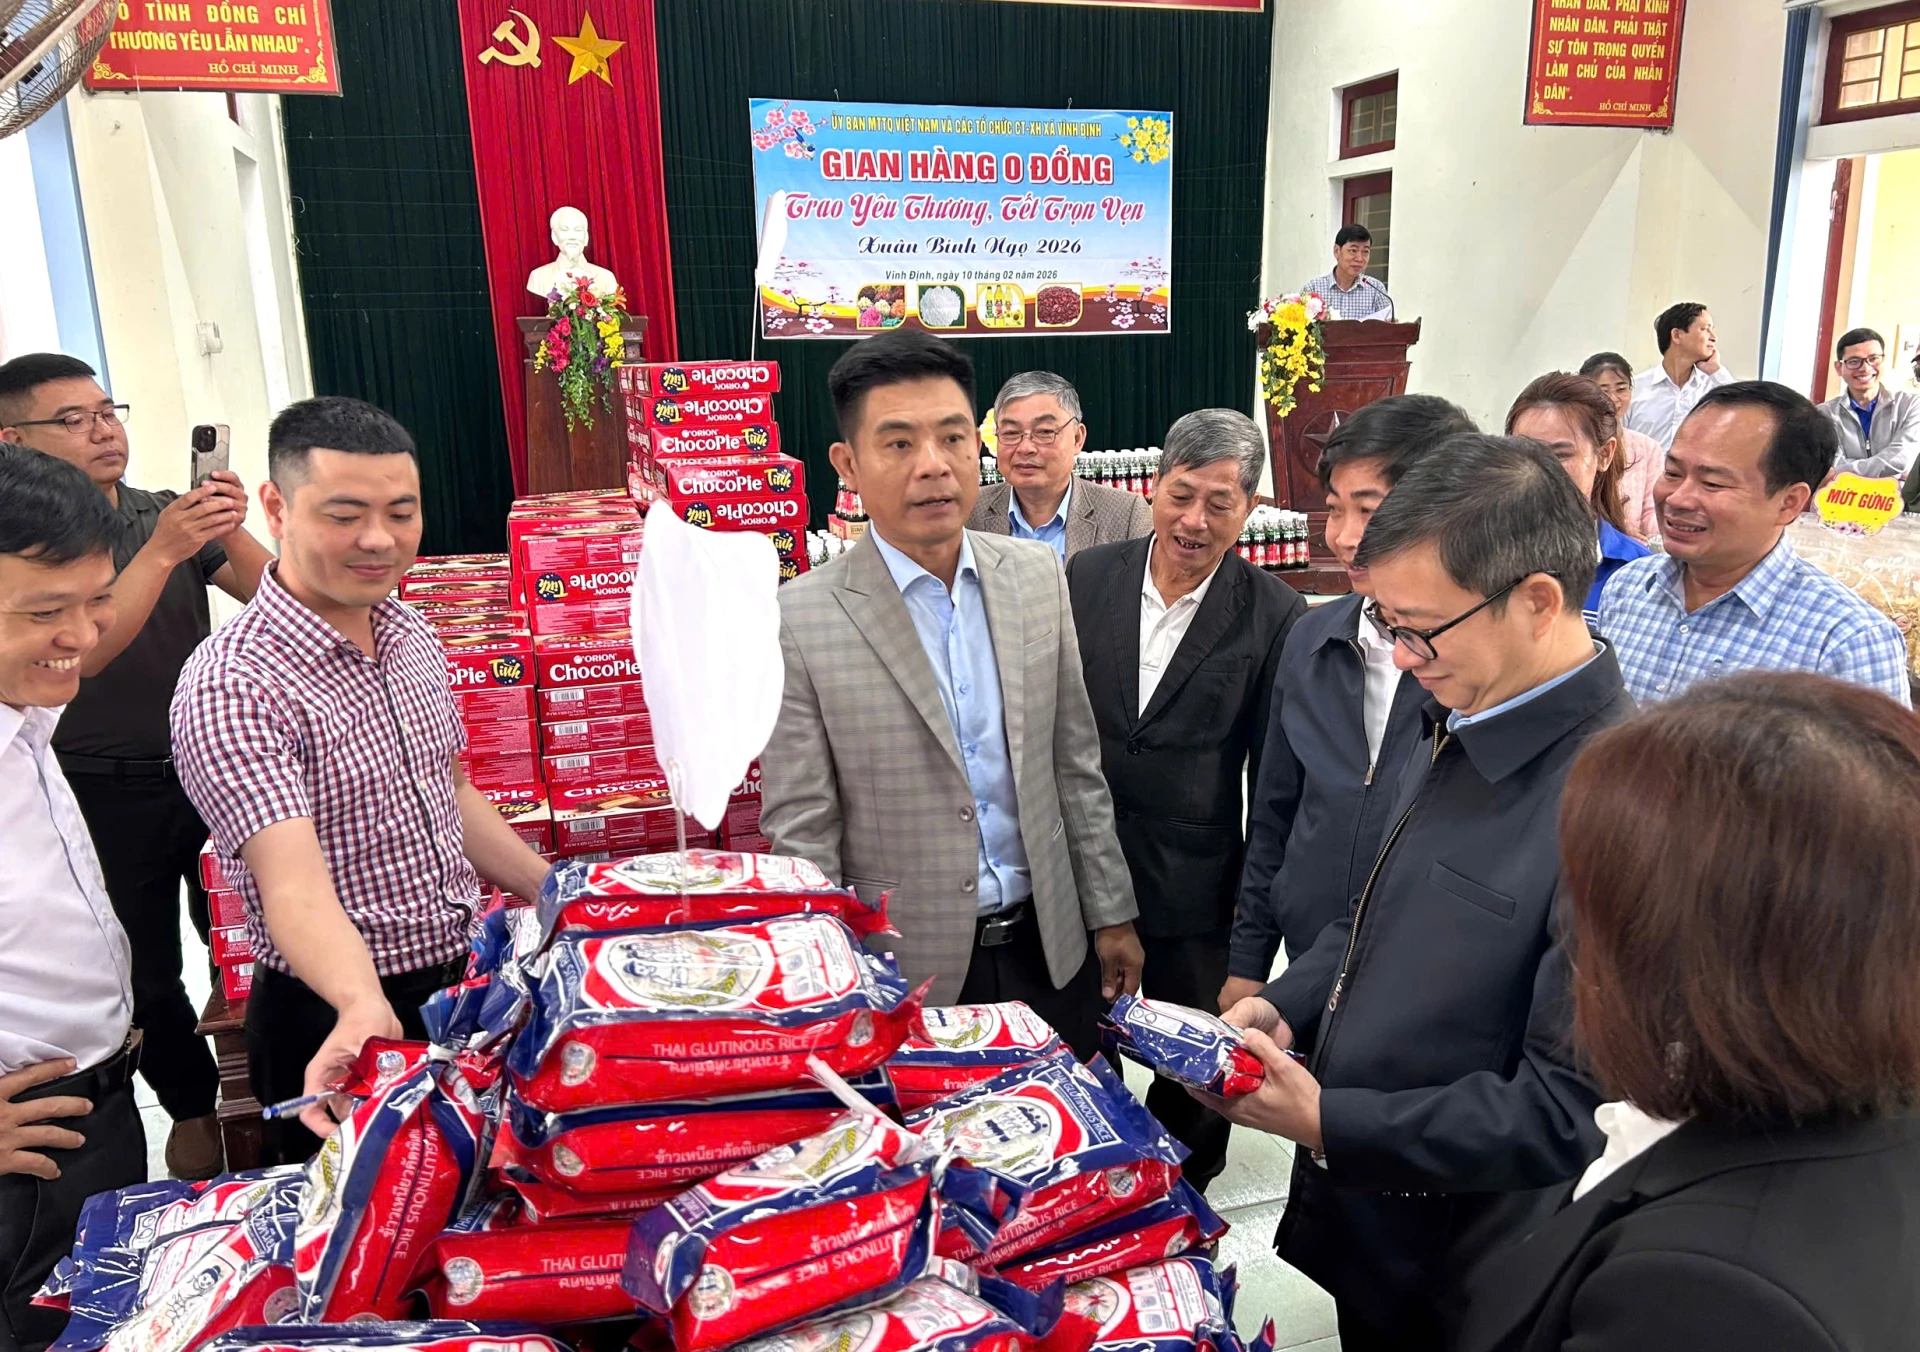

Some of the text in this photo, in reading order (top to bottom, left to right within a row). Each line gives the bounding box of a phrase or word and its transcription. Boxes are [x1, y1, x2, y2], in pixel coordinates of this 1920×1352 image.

[145, 0, 191, 22] TÌNH
[207, 0, 259, 23] ĐỒNG
[275, 3, 308, 25] CHÍ
[1549, 15, 1668, 39] NHÂN DÂN. PHẢI THẬT
[110, 31, 176, 50] THƯƠNG
[182, 29, 212, 51] YÊU
[216, 28, 249, 52] LẪN
[1547, 39, 1564, 57] SỰ
[1567, 38, 1588, 55] TÔN
[1593, 42, 1627, 59] TRỌNG
[208, 60, 299, 75] HỒ CHÍ MINH
[1545, 60, 1568, 78] LÀM
[1576, 58, 1598, 79] CHỦ
[1605, 60, 1626, 80] CỦA
[1629, 103, 1651, 112] MINH
[846, 115, 865, 131] BAN
[868, 116, 893, 133] MTTQ
[896, 114, 915, 135] VIỆT
[918, 116, 939, 133] NAM
[941, 115, 953, 133] VÀ
[955, 116, 973, 134] CÁC
[976, 114, 987, 134] TỔ
[989, 117, 1013, 135] CHỨC
[1015, 120, 1041, 136] CT-XH
[1044, 119, 1055, 136] XÃ
[1081, 122, 1102, 139] ĐỊNH
[822, 150, 900, 180] GIAN
[911, 147, 996, 181] HÀNG
[1029, 147, 1113, 182] ĐỒNG
[785, 193, 1145, 227] Trao Yêu Thương, Tết Trọn Vẹn
[858, 236, 918, 254] Xuân
[984, 237, 1028, 257] Ngọ
[1036, 238, 1082, 254] 2026
[909, 270, 934, 281] Định,
[936, 270, 960, 281] ngày
[962, 270, 973, 280] 10
[974, 270, 1001, 281] tháng
[1002, 270, 1014, 280] 02
[1015, 270, 1035, 280] năm
[1036, 270, 1058, 280] 2026
[691, 366, 770, 383] ChocoPie
[714, 382, 741, 391] ORION
[684, 397, 763, 414] ChocoPie
[707, 413, 734, 422] ORION
[689, 429, 718, 437] ORION
[661, 434, 740, 453] ChocoPie
[678, 475, 763, 495] ChocoPie
[716, 499, 799, 518] ChocoPie
[740, 516, 770, 526] ORION
[595, 587, 624, 595] ORION
[584, 653, 616, 662] ORION
[550, 656, 642, 682] ChocoPie
[564, 779, 666, 798] ChocoP
[652, 1036, 809, 1056] THAI GLUTINOUS RICE
[1051, 1069, 1112, 1142] THAI GLUTINOUS RICE
[636, 1166, 667, 1178] RICE
[406, 1142, 438, 1226] GLUTINOUS
[952, 1244, 979, 1260] THA
[1054, 1199, 1079, 1217] RICE
[393, 1226, 416, 1261] RICE
[541, 1254, 627, 1272] THAI GLUTI
[796, 1261, 829, 1283] RICE
[1098, 1259, 1124, 1274] RICE
